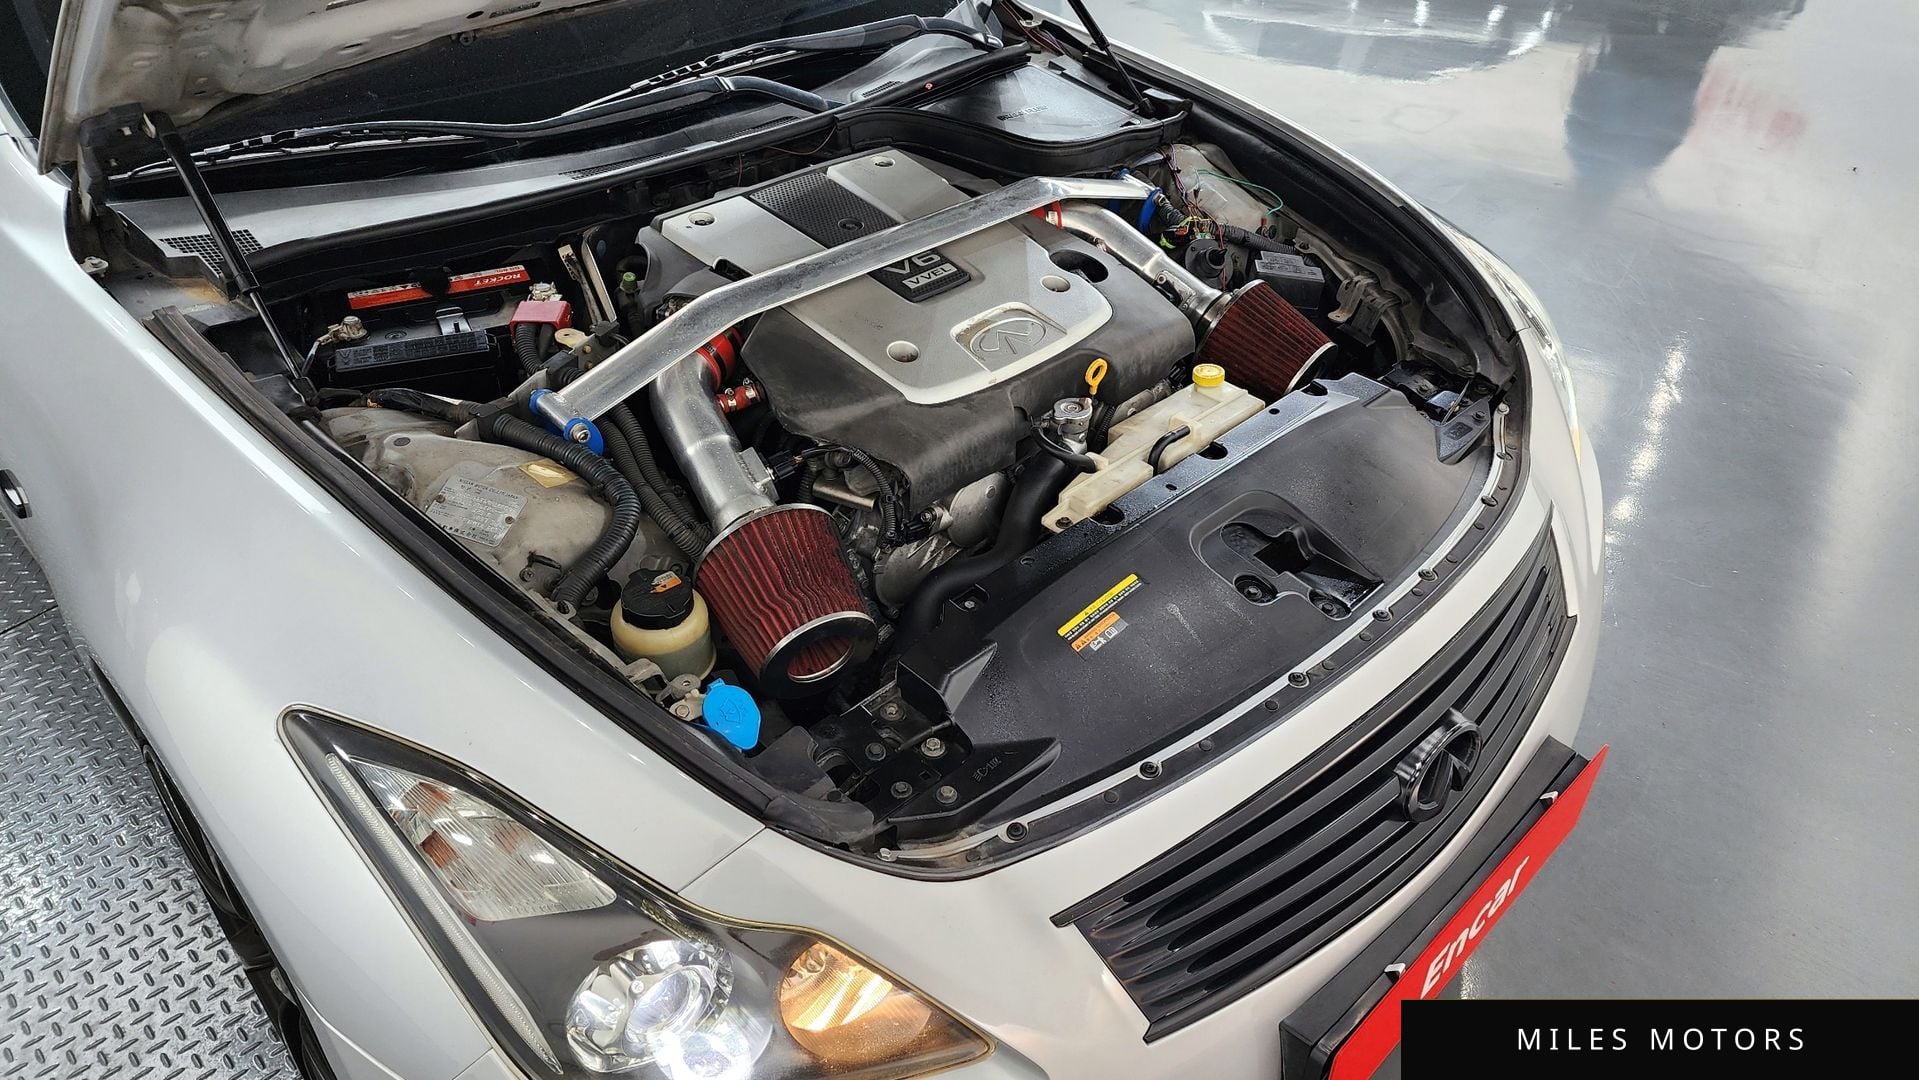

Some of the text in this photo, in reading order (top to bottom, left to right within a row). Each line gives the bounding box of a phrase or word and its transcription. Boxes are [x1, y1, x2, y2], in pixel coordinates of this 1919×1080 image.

[884, 251, 941, 275] V6
[474, 273, 521, 287] ROCKET
[908, 267, 952, 285] VVEL
[1420, 856, 1530, 1000] Encar
